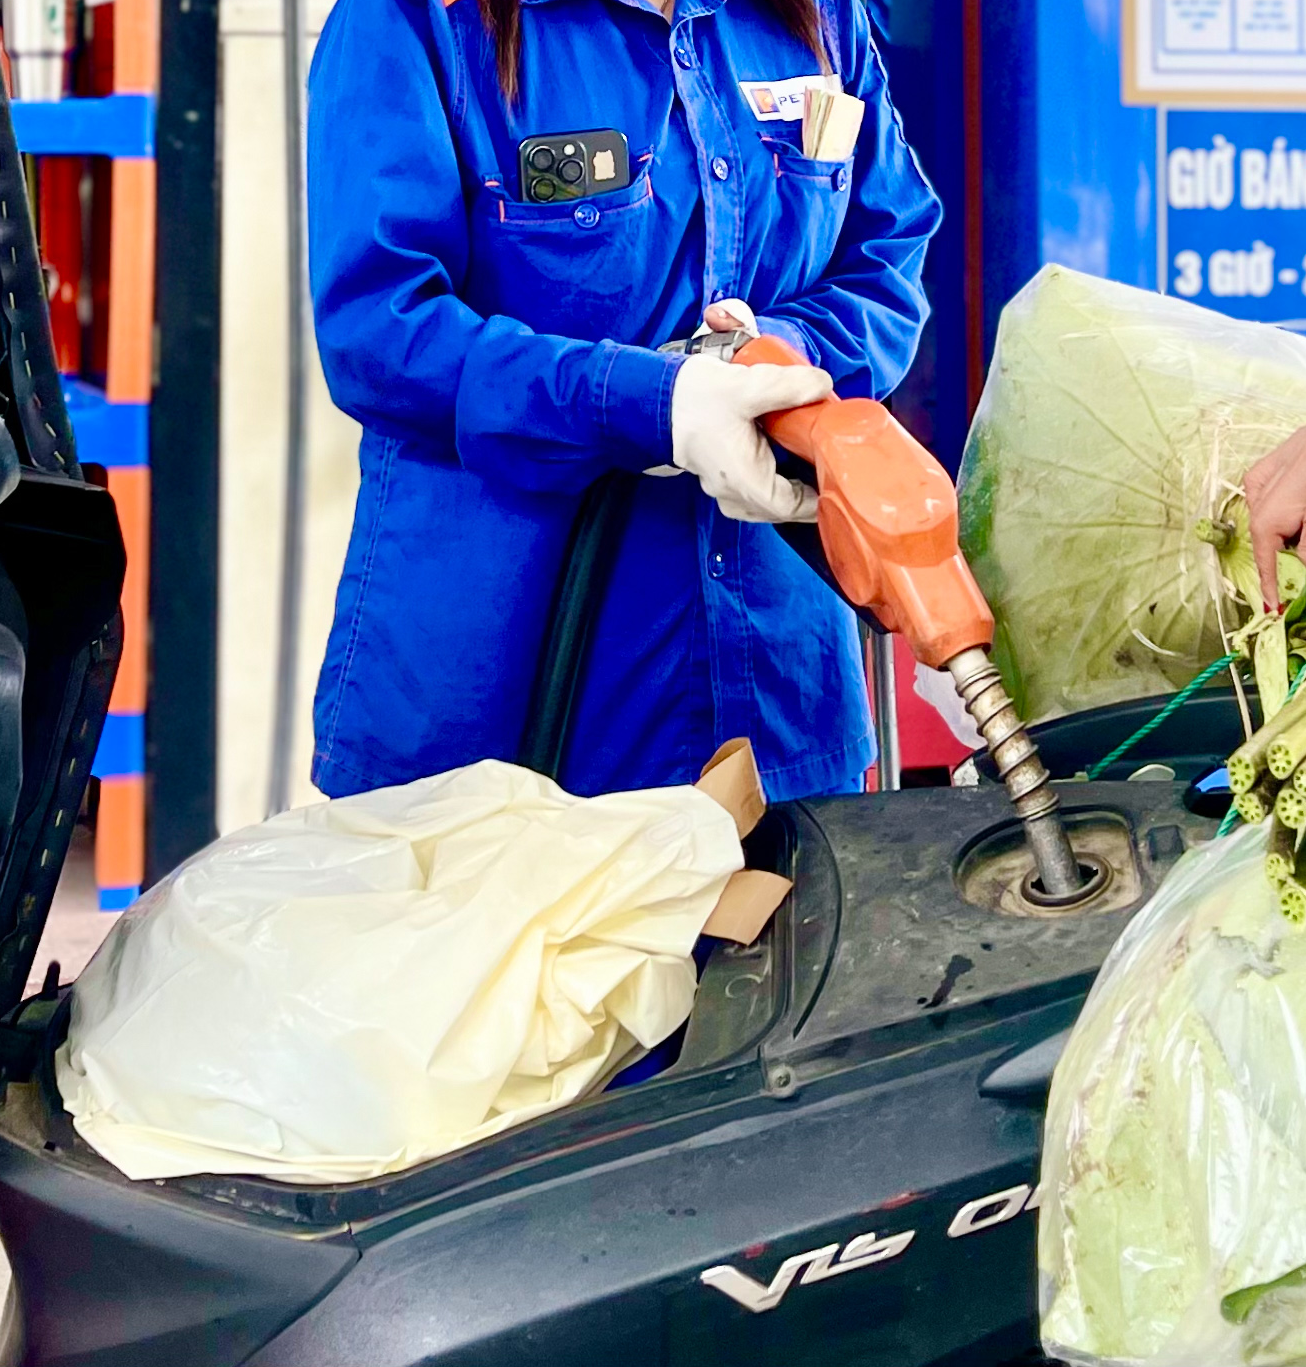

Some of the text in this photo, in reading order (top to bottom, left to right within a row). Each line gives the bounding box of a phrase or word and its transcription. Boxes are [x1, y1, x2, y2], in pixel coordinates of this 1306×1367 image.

[1167, 134, 1236, 210] GIỜ
[1173, 249, 1203, 297] 3
[1208, 240, 1276, 297] GIỜ
